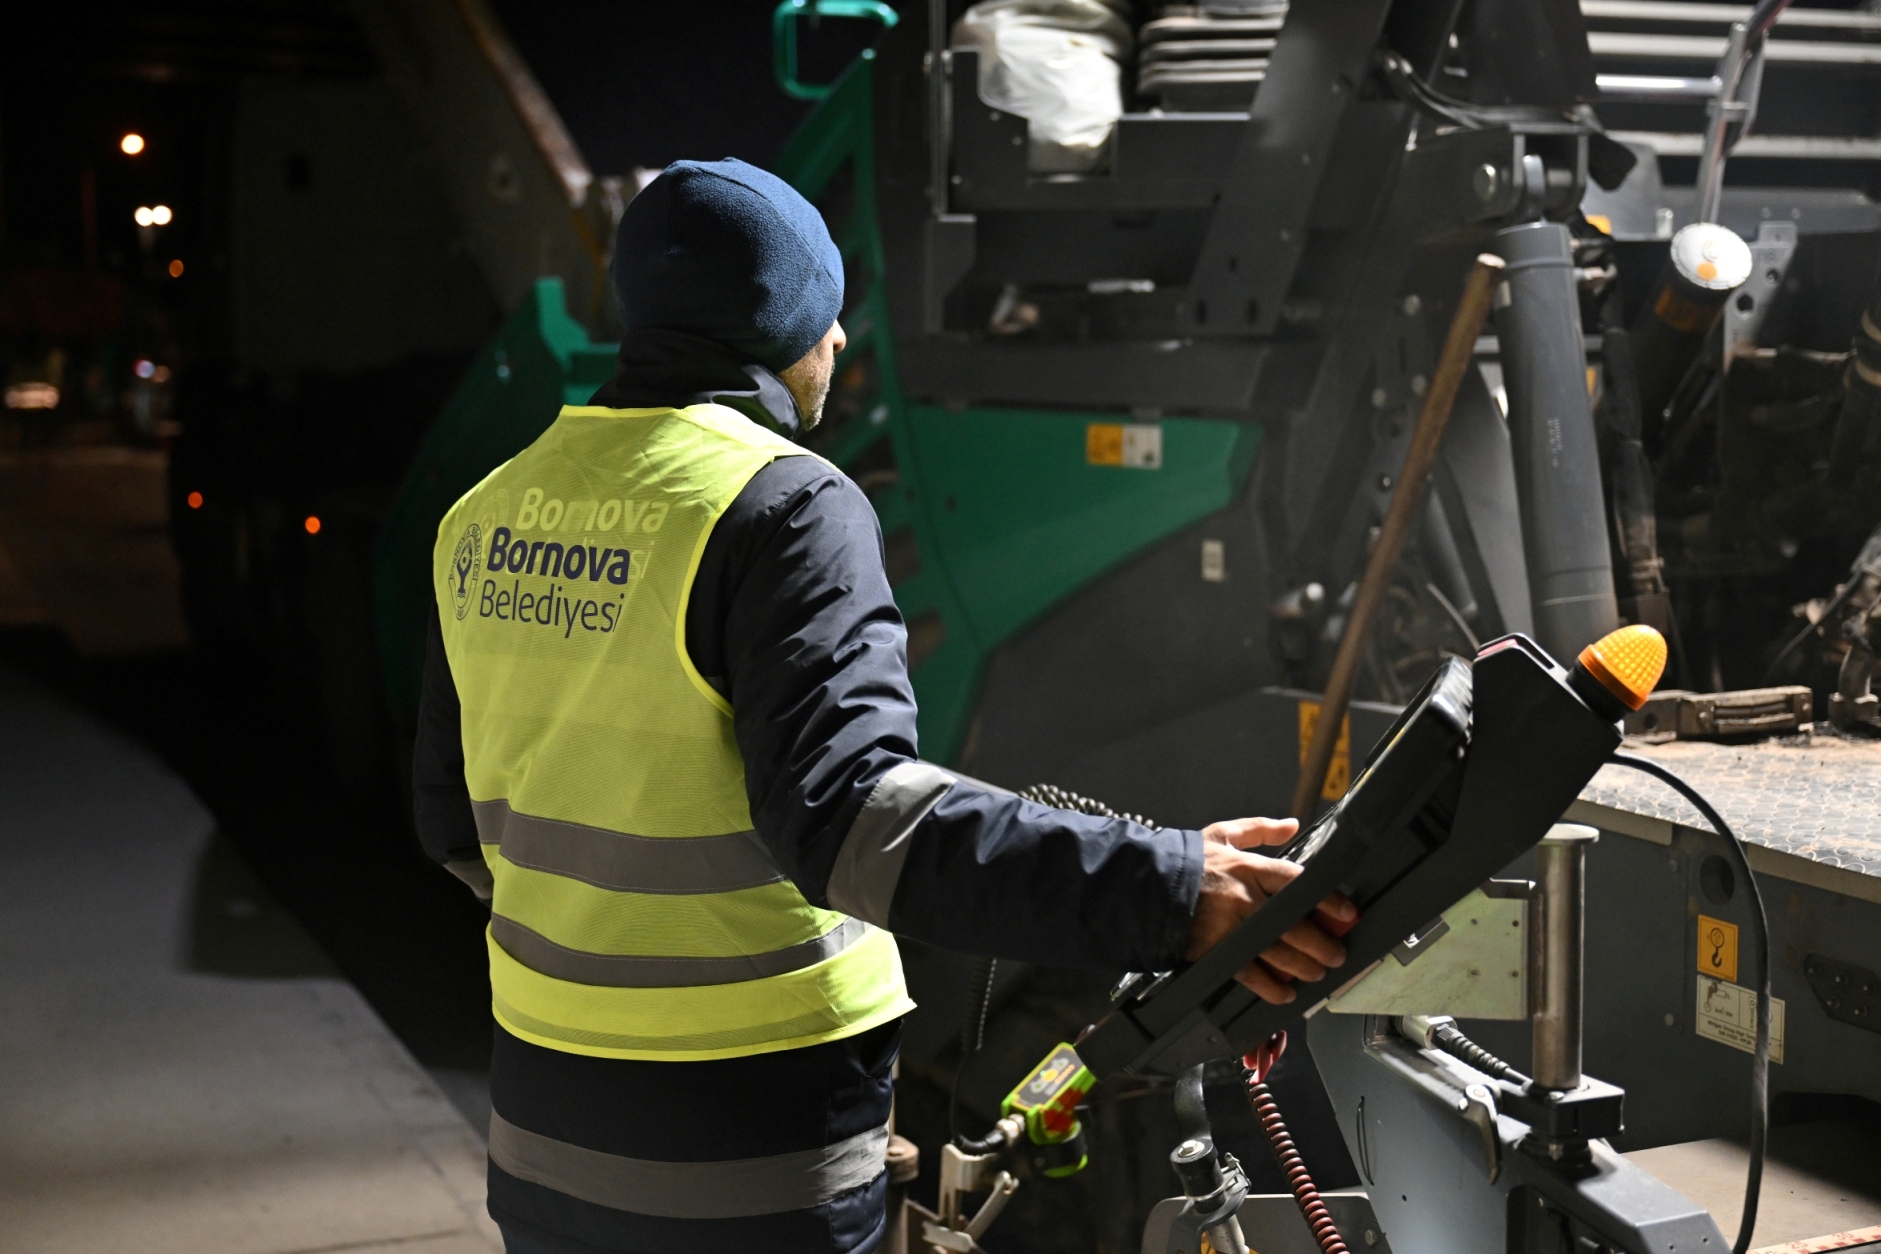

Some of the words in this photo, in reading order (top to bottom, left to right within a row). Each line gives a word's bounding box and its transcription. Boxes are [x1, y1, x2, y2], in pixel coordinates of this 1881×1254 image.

[515, 487, 669, 533] Bornova
[487, 527, 631, 585] Bornova
[479, 579, 625, 638] Belediyesi
